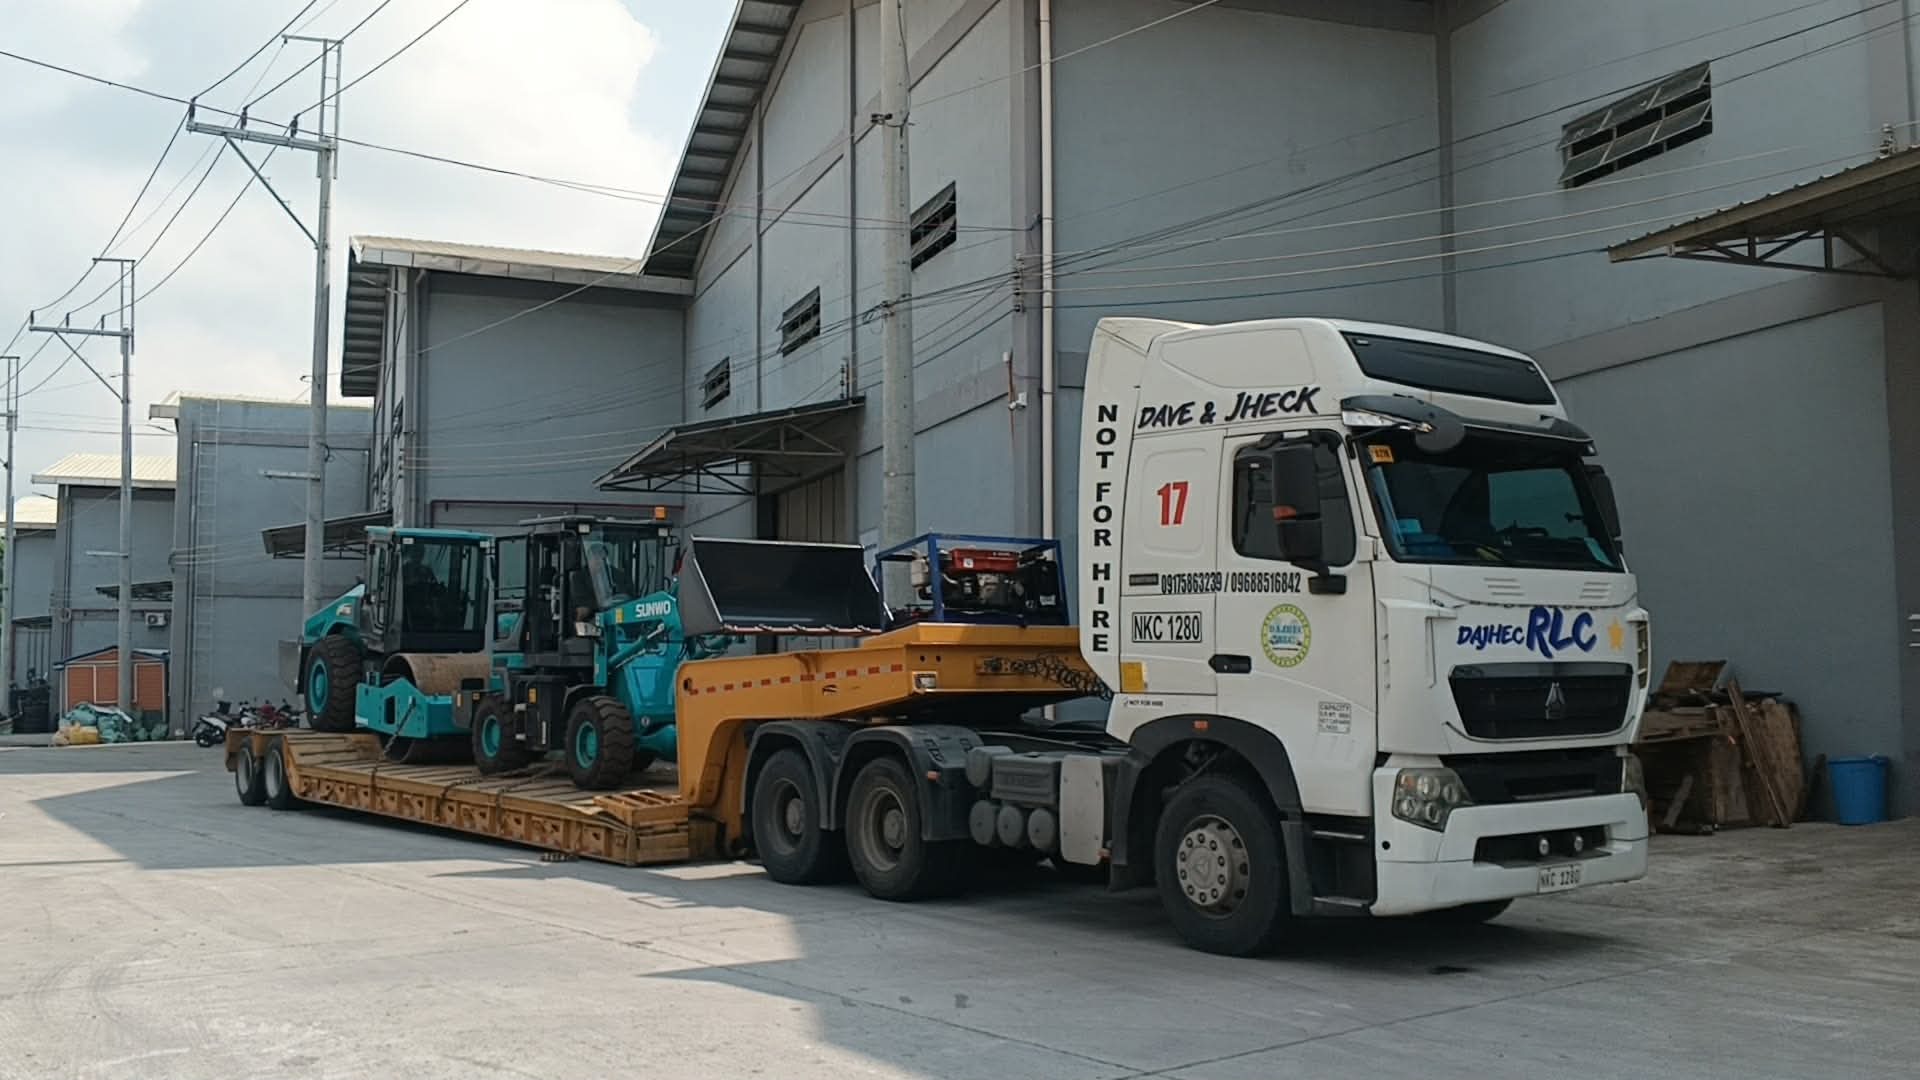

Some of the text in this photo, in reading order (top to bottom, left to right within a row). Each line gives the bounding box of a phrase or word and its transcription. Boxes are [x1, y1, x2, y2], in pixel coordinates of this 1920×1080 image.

[1138, 387, 1320, 429] DAVE & JHECK
[1157, 481, 1189, 526] 17
[1092, 405, 1118, 652] NOT FOR HIRE
[1161, 572, 1222, 594] 09175863239
[1231, 572, 1301, 593] 09688516842
[635, 600, 671, 618] SUNWO
[1134, 615, 1200, 640] NKC 1280
[1457, 606, 1597, 659] DAJHEC RLC
